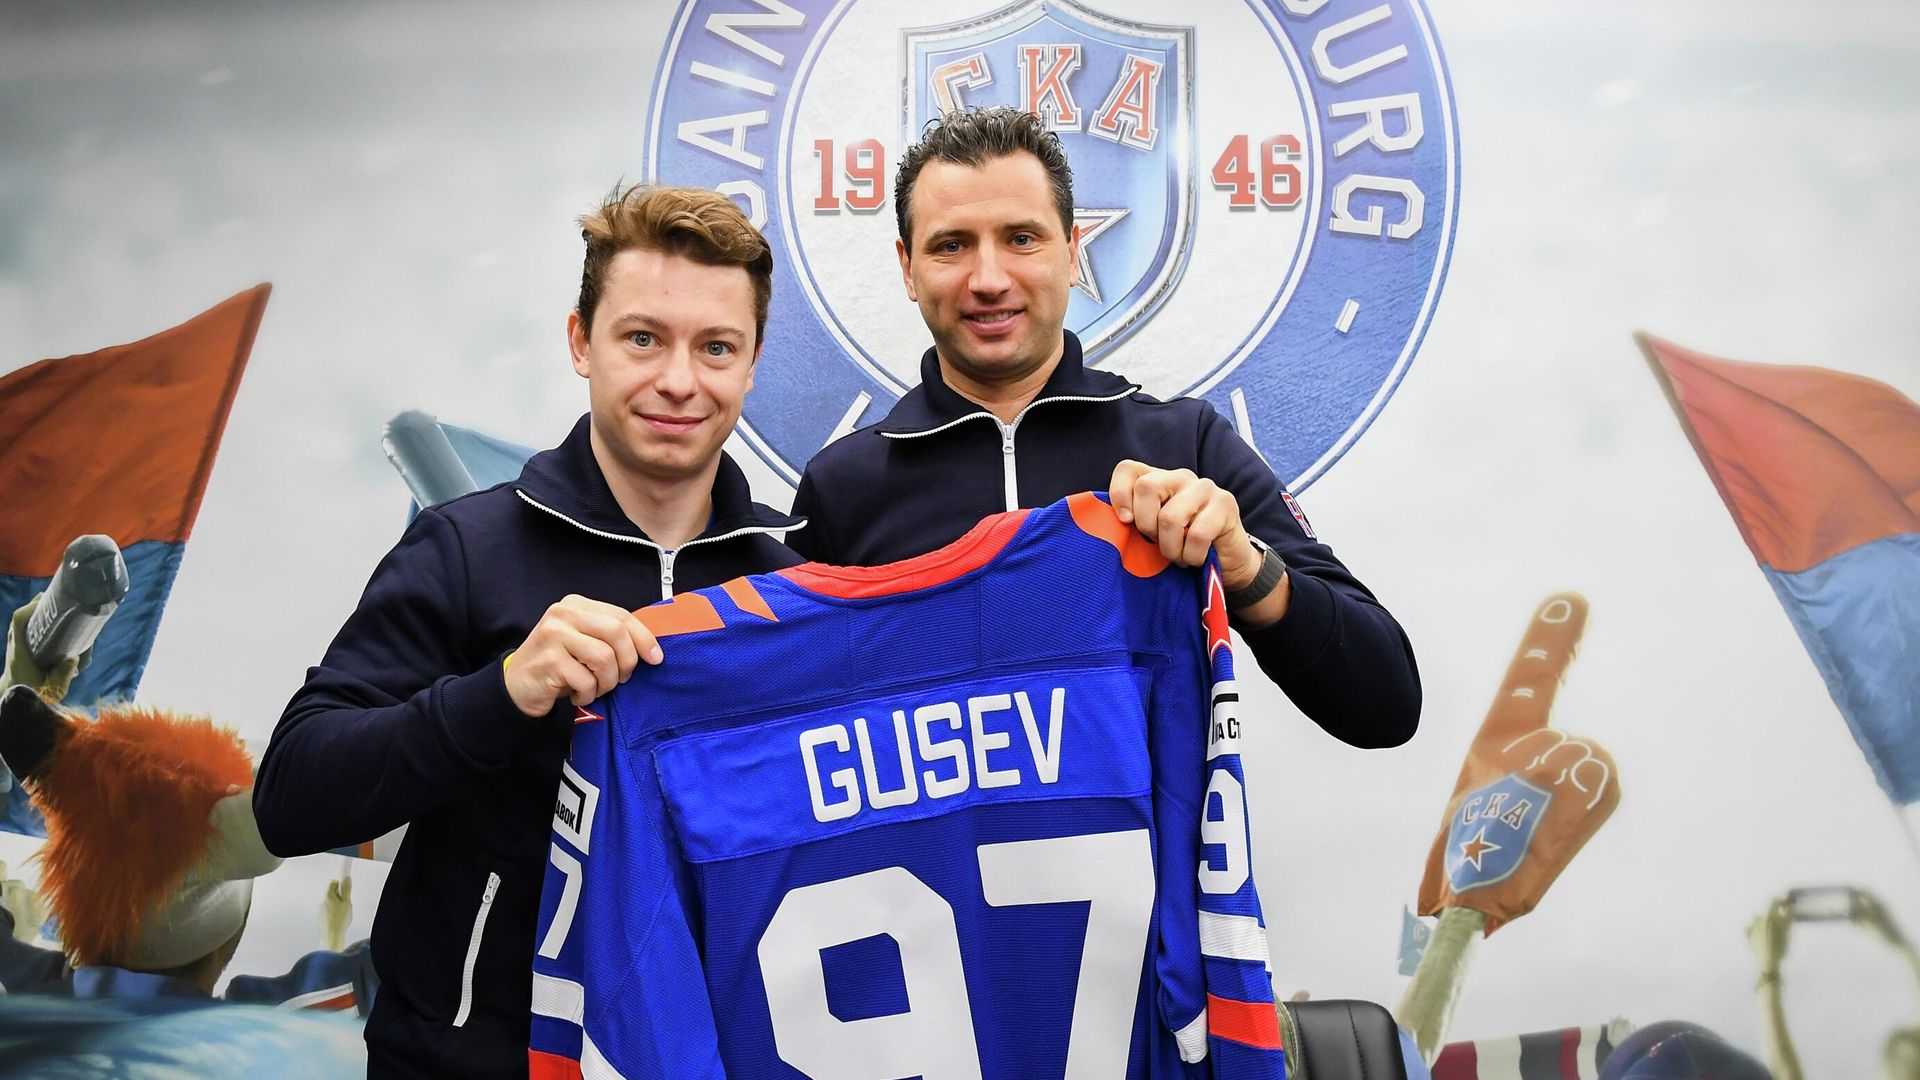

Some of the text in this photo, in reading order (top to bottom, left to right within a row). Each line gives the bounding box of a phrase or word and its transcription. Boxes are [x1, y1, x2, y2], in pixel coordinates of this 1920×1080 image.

[813, 134, 1303, 212] 19 46
[1280, 0, 1426, 240] URG
[800, 687, 1066, 823] GUSEV
[1463, 793, 1532, 831] СКА
[1198, 769, 1250, 895] 9
[537, 841, 583, 960] 7
[757, 828, 1156, 1080] 97
